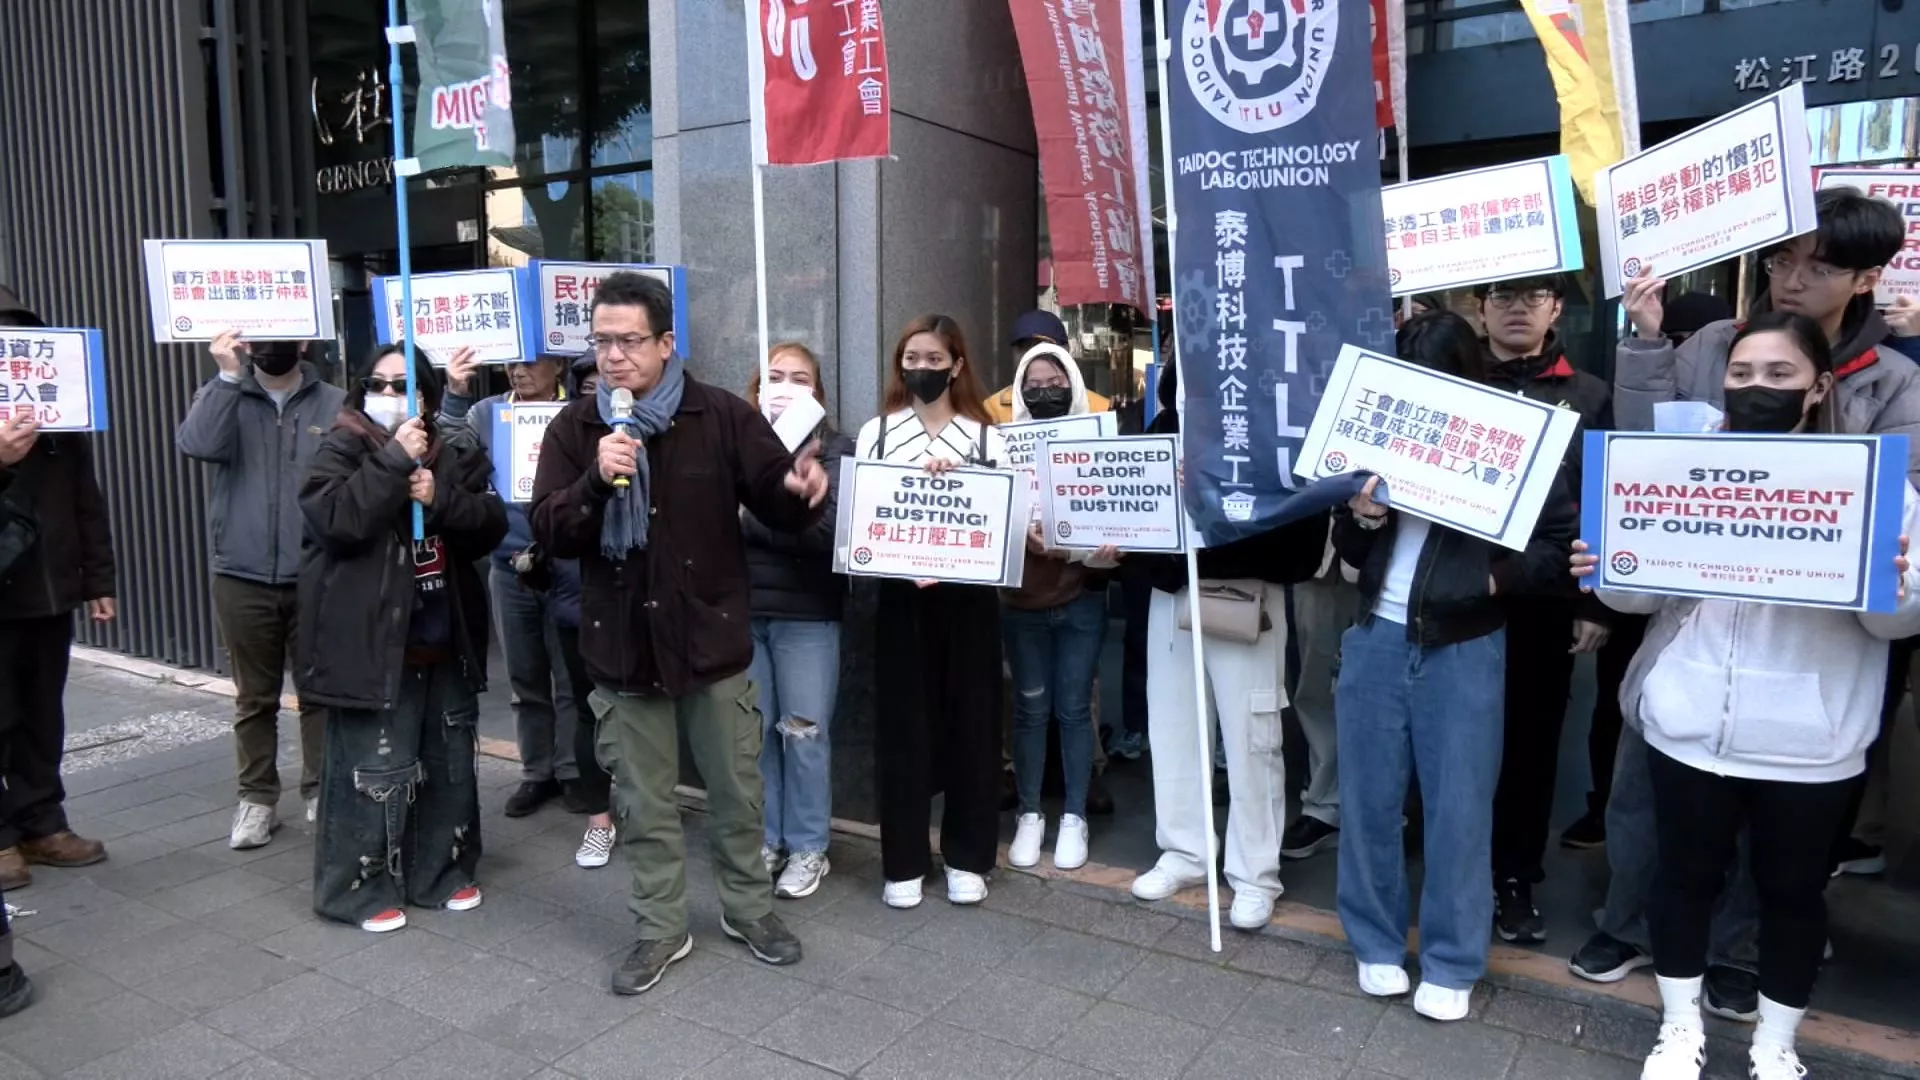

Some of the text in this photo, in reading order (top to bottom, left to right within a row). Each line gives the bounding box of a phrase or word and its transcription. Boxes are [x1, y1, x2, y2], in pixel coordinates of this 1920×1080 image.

[1178, 140, 1361, 176] TAIDOC TECHNOLOGY
[1617, 132, 1774, 216] 強迫勞動的慣犯
[1620, 158, 1777, 240] 變為勞權詐騙犯
[1214, 208, 1258, 522] 泰博科技企業工會
[1052, 450, 1171, 464] END FORCED
[1076, 466, 1146, 478] LABOR!
[1689, 467, 1770, 484] STOP
[900, 475, 964, 492] STOP
[1055, 484, 1172, 497] STOP UNION
[1613, 482, 1854, 506] MANAGEMENT
[893, 491, 973, 510] UNION
[1069, 500, 1159, 513] BUSTING!
[875, 506, 988, 526] BUSTING!
[1624, 501, 1839, 524] INFILTRATION
[867, 520, 993, 549] 停止打壓工會!
[1619, 517, 1843, 543] OF OUR UNION!
